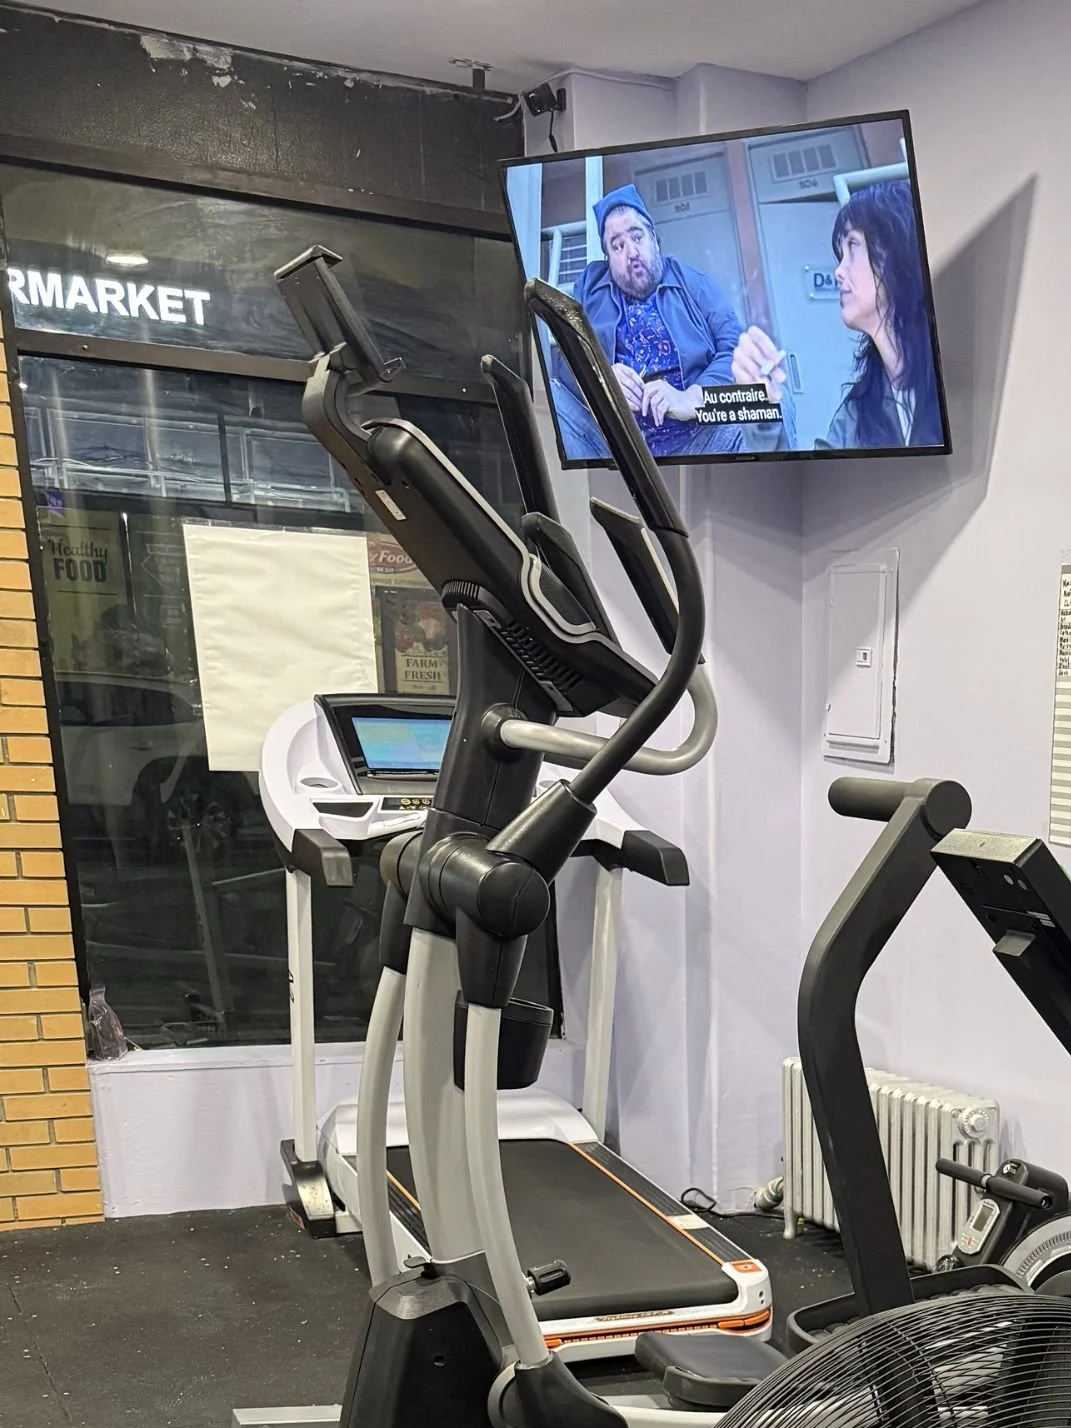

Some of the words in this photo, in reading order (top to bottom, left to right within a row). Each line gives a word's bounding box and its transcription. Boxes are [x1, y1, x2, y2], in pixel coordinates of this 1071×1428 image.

[704, 390, 717, 404] Au
[719, 388, 768, 404] contraire.
[695, 408, 727, 422] You're
[729, 412, 736, 421] a
[738, 406, 783, 420] shaman.
[54, 558, 107, 583] FOOD
[406, 658, 438, 668] FARM
[404, 670, 441, 680] FRESH
